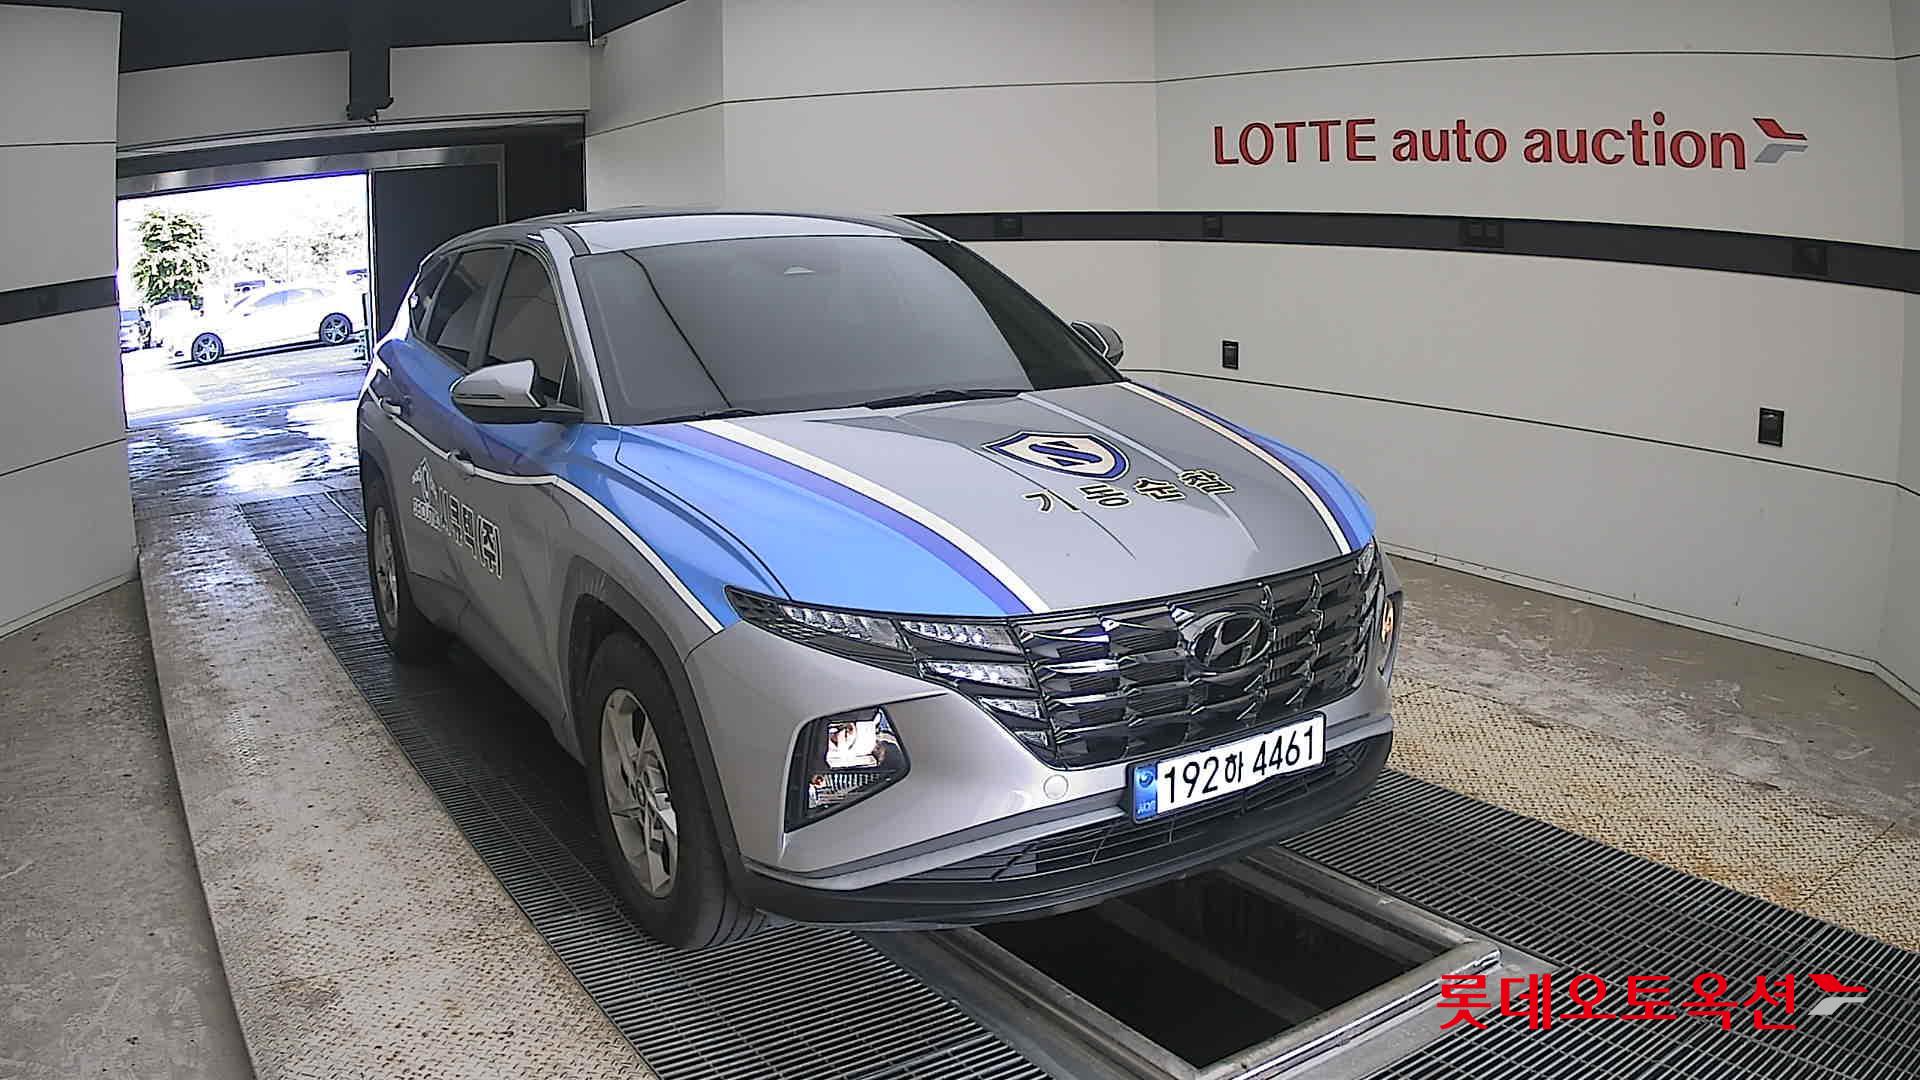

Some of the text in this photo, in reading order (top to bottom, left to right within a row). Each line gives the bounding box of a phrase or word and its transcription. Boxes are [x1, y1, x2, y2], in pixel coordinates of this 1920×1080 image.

[1213, 111, 1747, 170] LOTTE auto auction
[1164, 725, 1314, 804] 192하 4461
